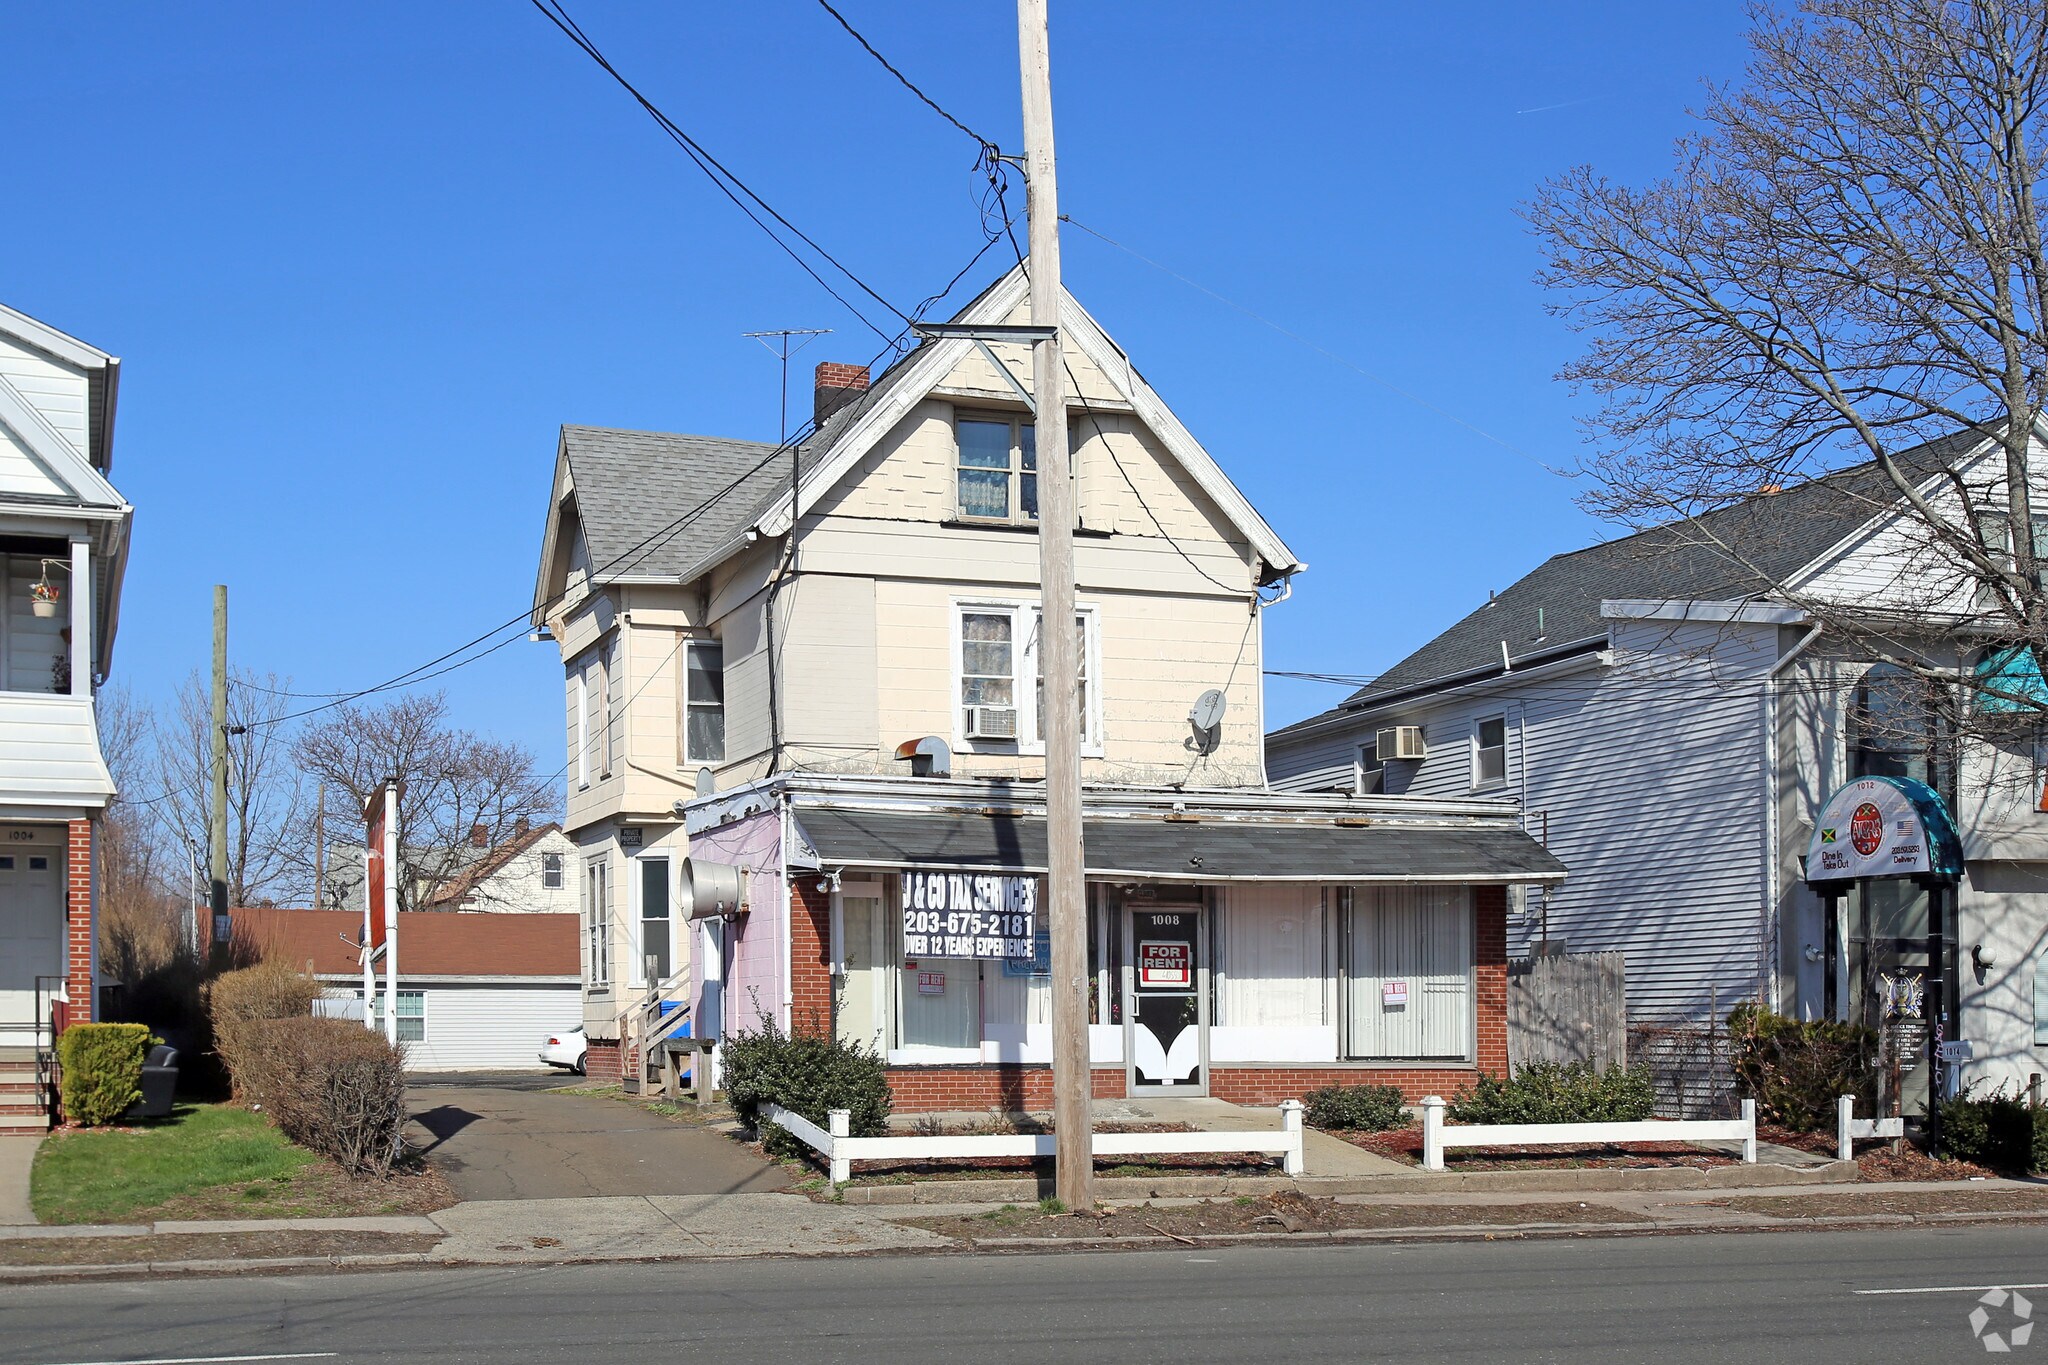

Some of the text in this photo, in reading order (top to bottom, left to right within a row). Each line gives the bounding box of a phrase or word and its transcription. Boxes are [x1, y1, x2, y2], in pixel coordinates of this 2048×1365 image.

[1857, 781, 1875, 790] 1012
[9, 831, 34, 840] 1004
[1822, 850, 1842, 861] Dine In
[1894, 855, 1918, 864] Delivery
[1823, 860, 1849, 870] Take Out
[914, 872, 925, 909] &
[927, 872, 946, 910] CO
[948, 873, 973, 911] TAX
[974, 874, 1035, 913] SERVICES
[905, 911, 1033, 937] 203-675-2181
[1151, 915, 1180, 925] 1008
[905, 935, 928, 954] OVER
[931, 936, 943, 955] 12
[944, 936, 974, 956] YEARS
[976, 937, 1033, 957] EXPERIENCE
[1149, 947, 1180, 957] FOR
[1144, 958, 1186, 968] RENT
[919, 974, 944, 985] FOR RENT
[1384, 983, 1406, 993] FOR RENT
